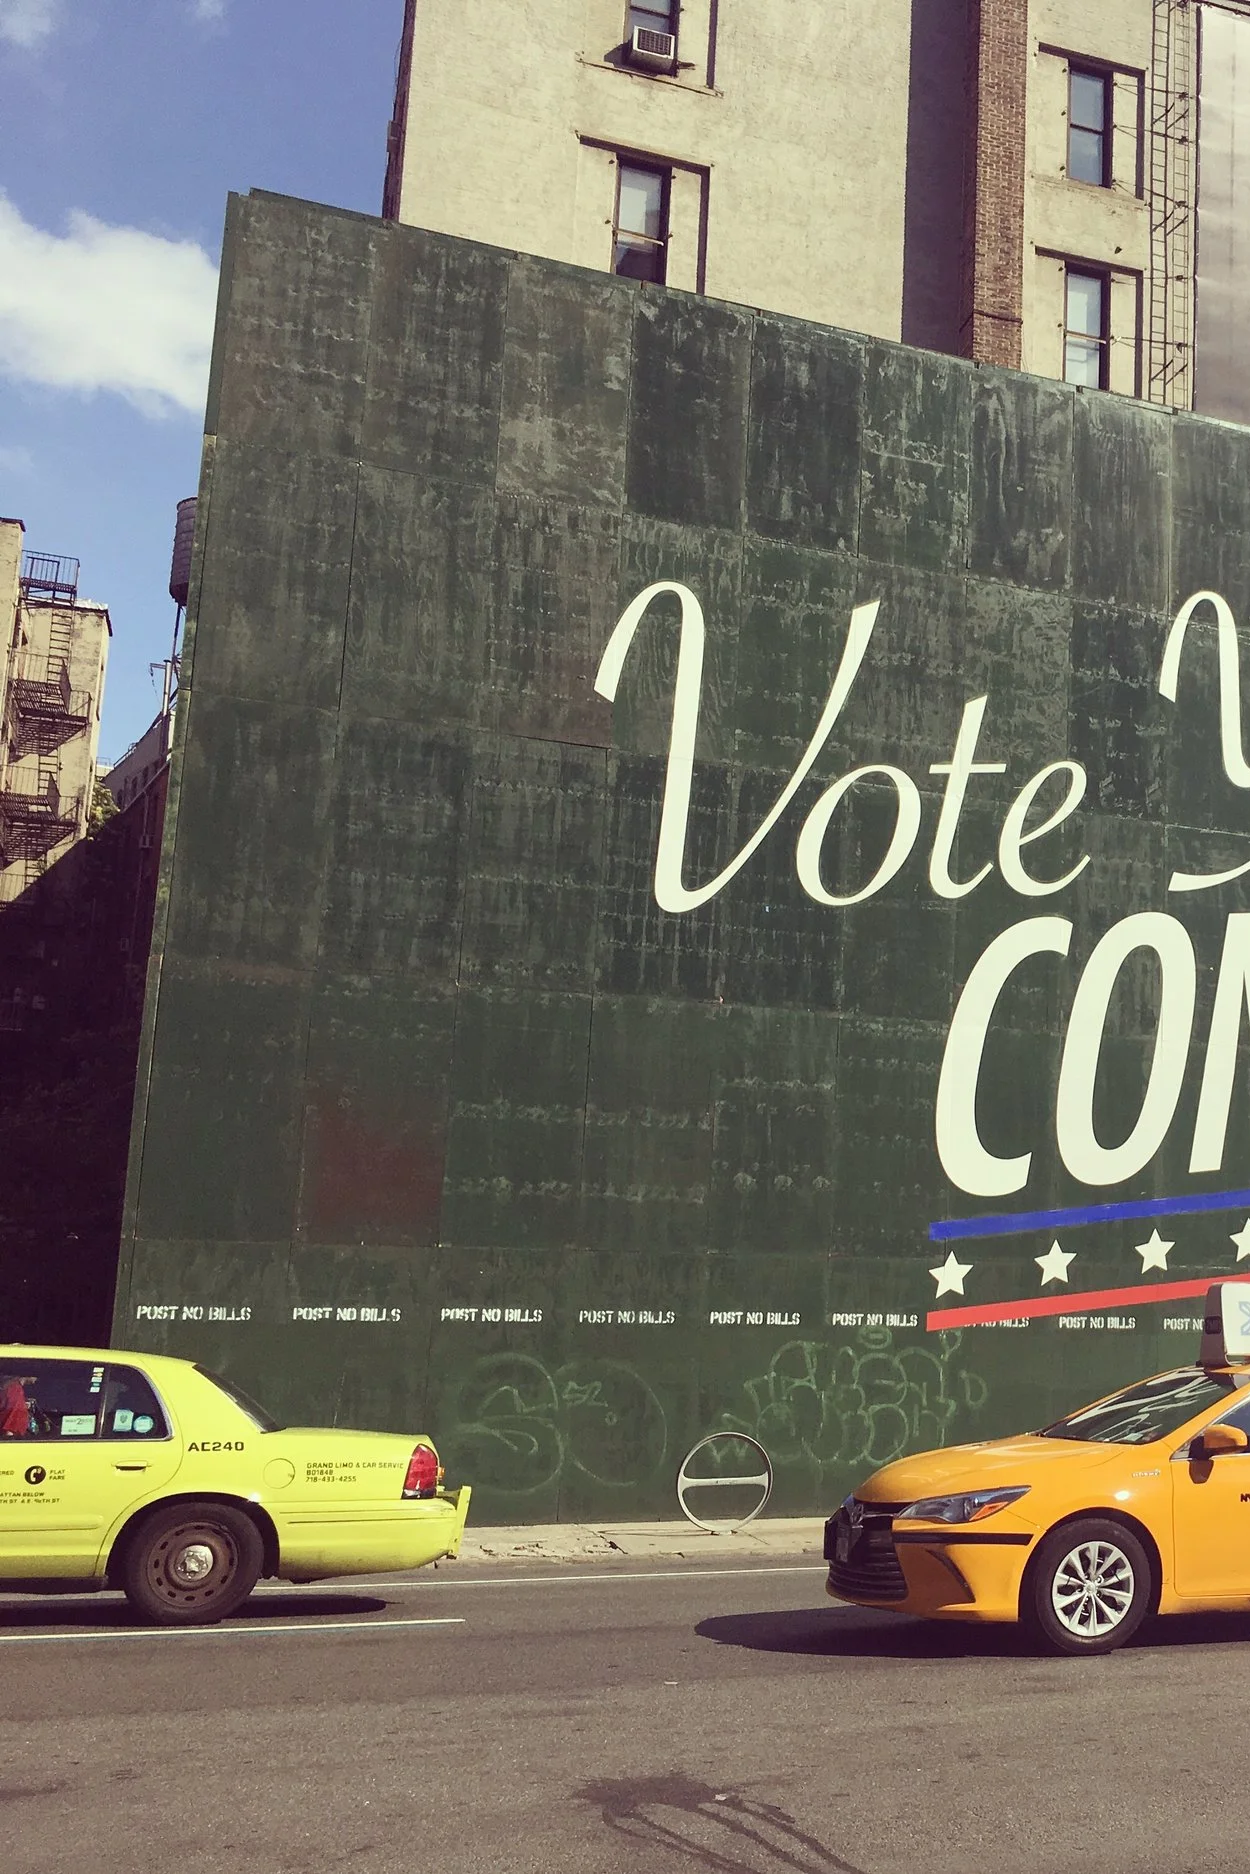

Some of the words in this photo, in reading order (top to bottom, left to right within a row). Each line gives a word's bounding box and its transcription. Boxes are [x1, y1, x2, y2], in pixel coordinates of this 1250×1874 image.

[594, 581, 1092, 914] Vote
[136, 1305, 179, 1320] POST
[182, 1306, 203, 1320] NO
[208, 1307, 252, 1321] BILLS
[293, 1307, 332, 1320] POST
[336, 1307, 357, 1321] NO
[360, 1308, 401, 1322] BILLS
[441, 1308, 479, 1321] POST
[482, 1308, 501, 1322] NO
[504, 1308, 543, 1322] BILLS
[579, 1310, 614, 1323] POST
[617, 1310, 635, 1324] NO
[638, 1311, 676, 1325] BILLS
[710, 1311, 743, 1324] POST
[746, 1311, 763, 1325] NO
[766, 1311, 801, 1326] BILLS
[832, 1312, 864, 1327] POST
[866, 1312, 883, 1326] NO
[885, 1312, 919, 1328] BILLS
[1059, 1316, 1088, 1329] POST
[1089, 1316, 1105, 1329] NO
[1107, 1316, 1136, 1330] BILLS
[1163, 1318, 1191, 1331] POST
[188, 1441, 245, 1452] AC240
